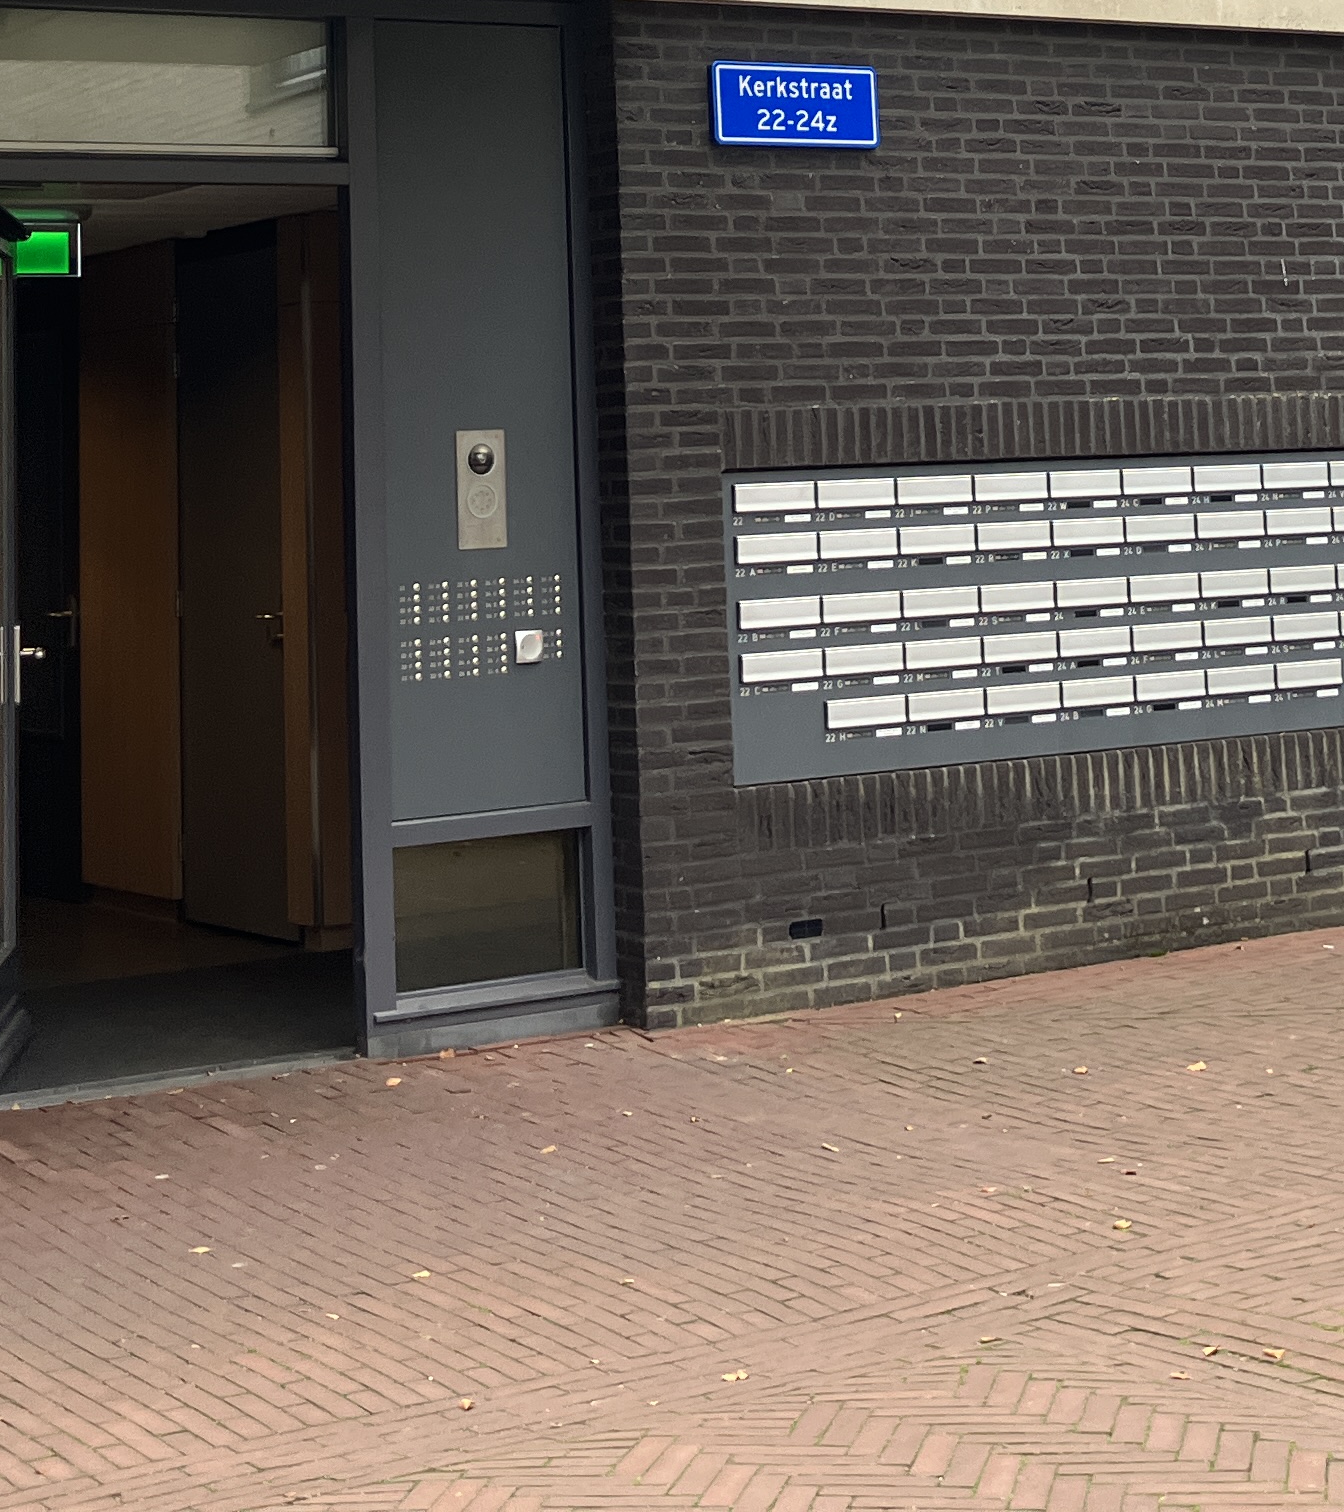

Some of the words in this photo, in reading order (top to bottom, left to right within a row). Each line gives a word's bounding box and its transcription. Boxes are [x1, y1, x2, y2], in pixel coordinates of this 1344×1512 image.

[738, 74, 853, 100] Kerkstraat
[757, 108, 838, 132] 22-24z
[1261, 493, 1270, 501] 24
[1328, 490, 1337, 498] 24
[1121, 499, 1130, 507] 24
[1133, 498, 1139, 507] C
[1192, 496, 1201, 505] 24
[973, 506, 983, 514] 22
[986, 505, 991, 514] P
[1048, 502, 1057, 511] 22
[1060, 502, 1068, 510] W
[816, 513, 826, 522] 22
[829, 512, 836, 522] D
[895, 509, 905, 518] 22
[733, 517, 743, 526] 22
[1265, 539, 1273, 547] 24
[1332, 536, 1340, 544] 24
[1124, 547, 1133, 555] 24
[1195, 543, 1204, 551] 24
[975, 555, 985, 564] 22
[988, 554, 994, 563] R
[1051, 551, 1060, 559] 22
[1064, 550, 1070, 559] X
[898, 559, 908, 568] 22
[911, 558, 918, 567] K
[818, 564, 828, 573] 22
[831, 563, 838, 572] E
[735, 569, 746, 578] 22
[750, 568, 756, 577] A
[1336, 593, 1344, 601] 24
[1199, 602, 1208, 611] 24
[1268, 598, 1277, 606] 24
[1128, 607, 1137, 616] 24
[1054, 612, 1064, 621] 24
[979, 617, 988, 626] 22
[901, 622, 911, 632] 22
[914, 622, 920, 631] L
[820, 628, 831, 637] 22
[834, 627, 840, 636] F
[738, 634, 748, 643] 22
[752, 633, 758, 642] B
[1271, 645, 1281, 654] 24
[1202, 650, 1211, 659] 24
[1131, 656, 1140, 665] 24
[1057, 662, 1067, 671] 24
[1070, 661, 1077, 669] A
[982, 667, 992, 677] 22
[904, 674, 913, 683] 22
[917, 673, 924, 682] M
[823, 681, 833, 690] 22
[740, 687, 750, 697] 22
[754, 686, 761, 696] C
[1275, 693, 1283, 702] 24
[1206, 699, 1215, 708] 24
[1134, 706, 1143, 714] 24
[1060, 713, 1070, 722] 24
[1073, 711, 1079, 720] B
[984, 719, 994, 728] 22
[907, 726, 916, 735] 22
[826, 733, 836, 743] 22
[839, 732, 846, 741] H
